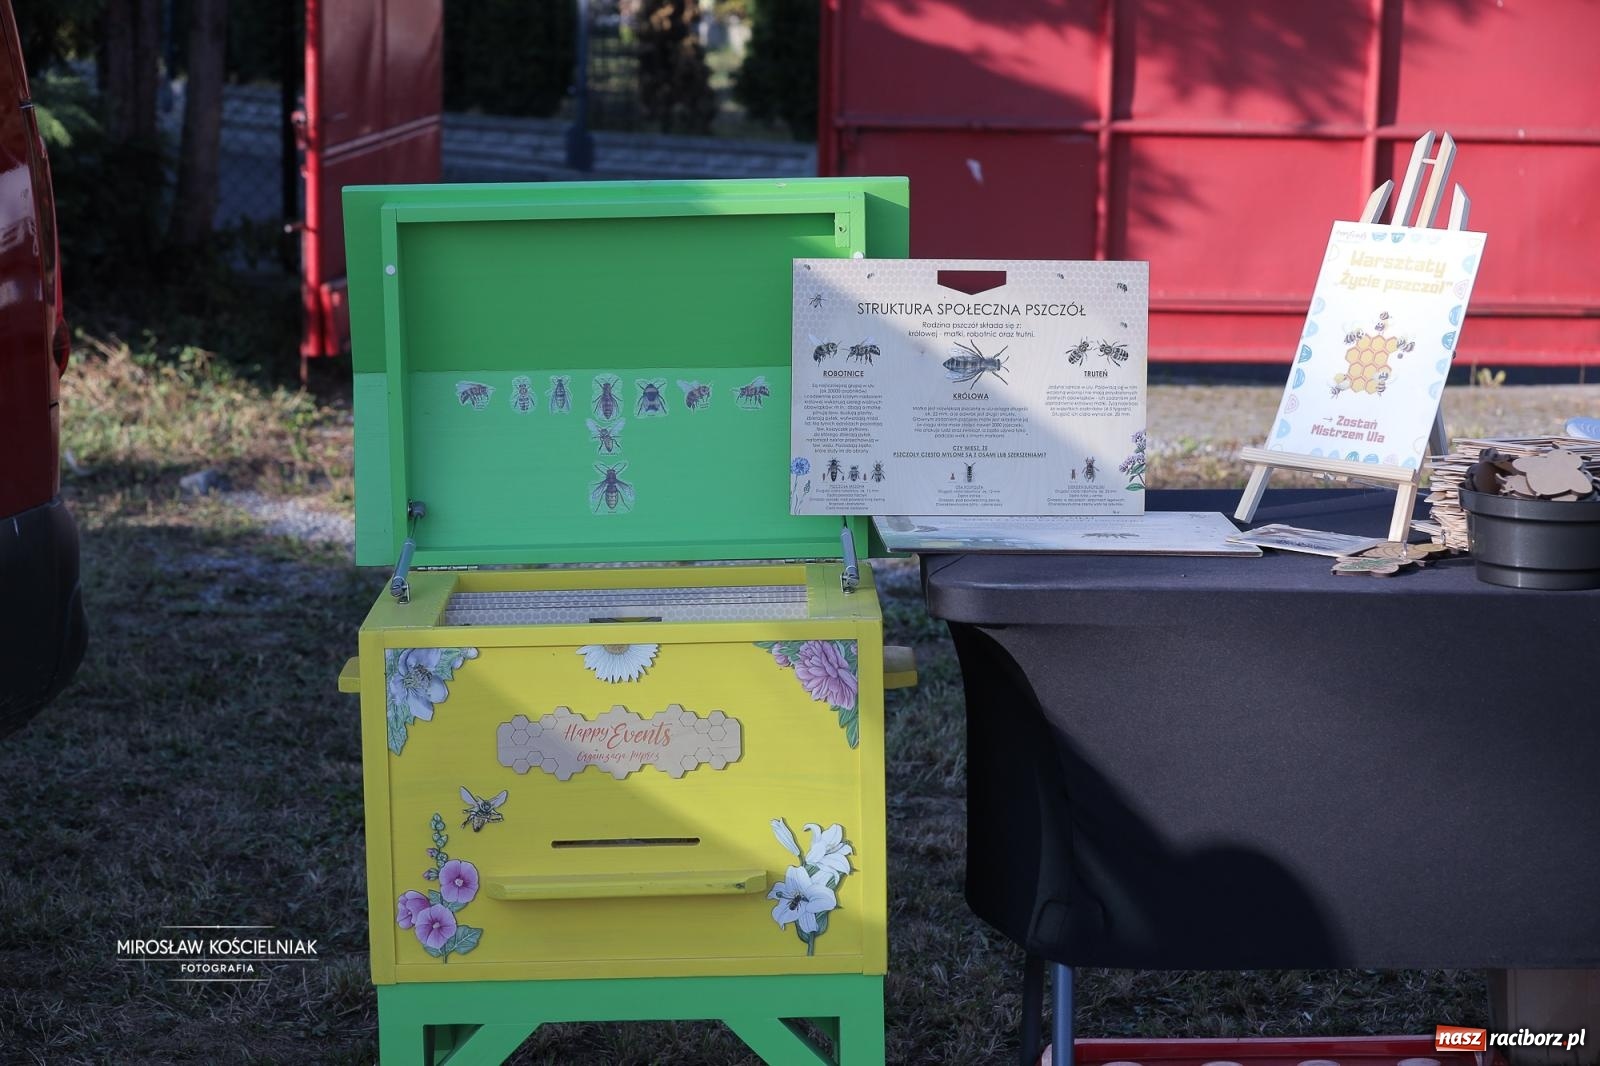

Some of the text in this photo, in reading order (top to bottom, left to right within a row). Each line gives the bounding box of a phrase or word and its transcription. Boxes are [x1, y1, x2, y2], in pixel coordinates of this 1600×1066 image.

[1350, 250, 1447, 278] Warsztaty
[857, 303, 1086, 316] STRUKTURA SPOŁECZNA PSZCZÓŁ
[922, 321, 951, 329] Rodzina
[952, 321, 978, 331] pszczół
[980, 321, 1003, 329] składa
[1005, 322, 1016, 331] się
[908, 330, 938, 338] królowej
[966, 330, 997, 338] robotnic
[1084, 369, 1108, 377] TRUTEŃ
[1336, 415, 1378, 430] Zostań
[1310, 424, 1385, 443] Mistrzem Ula
[564, 720, 673, 749] Happy Events
